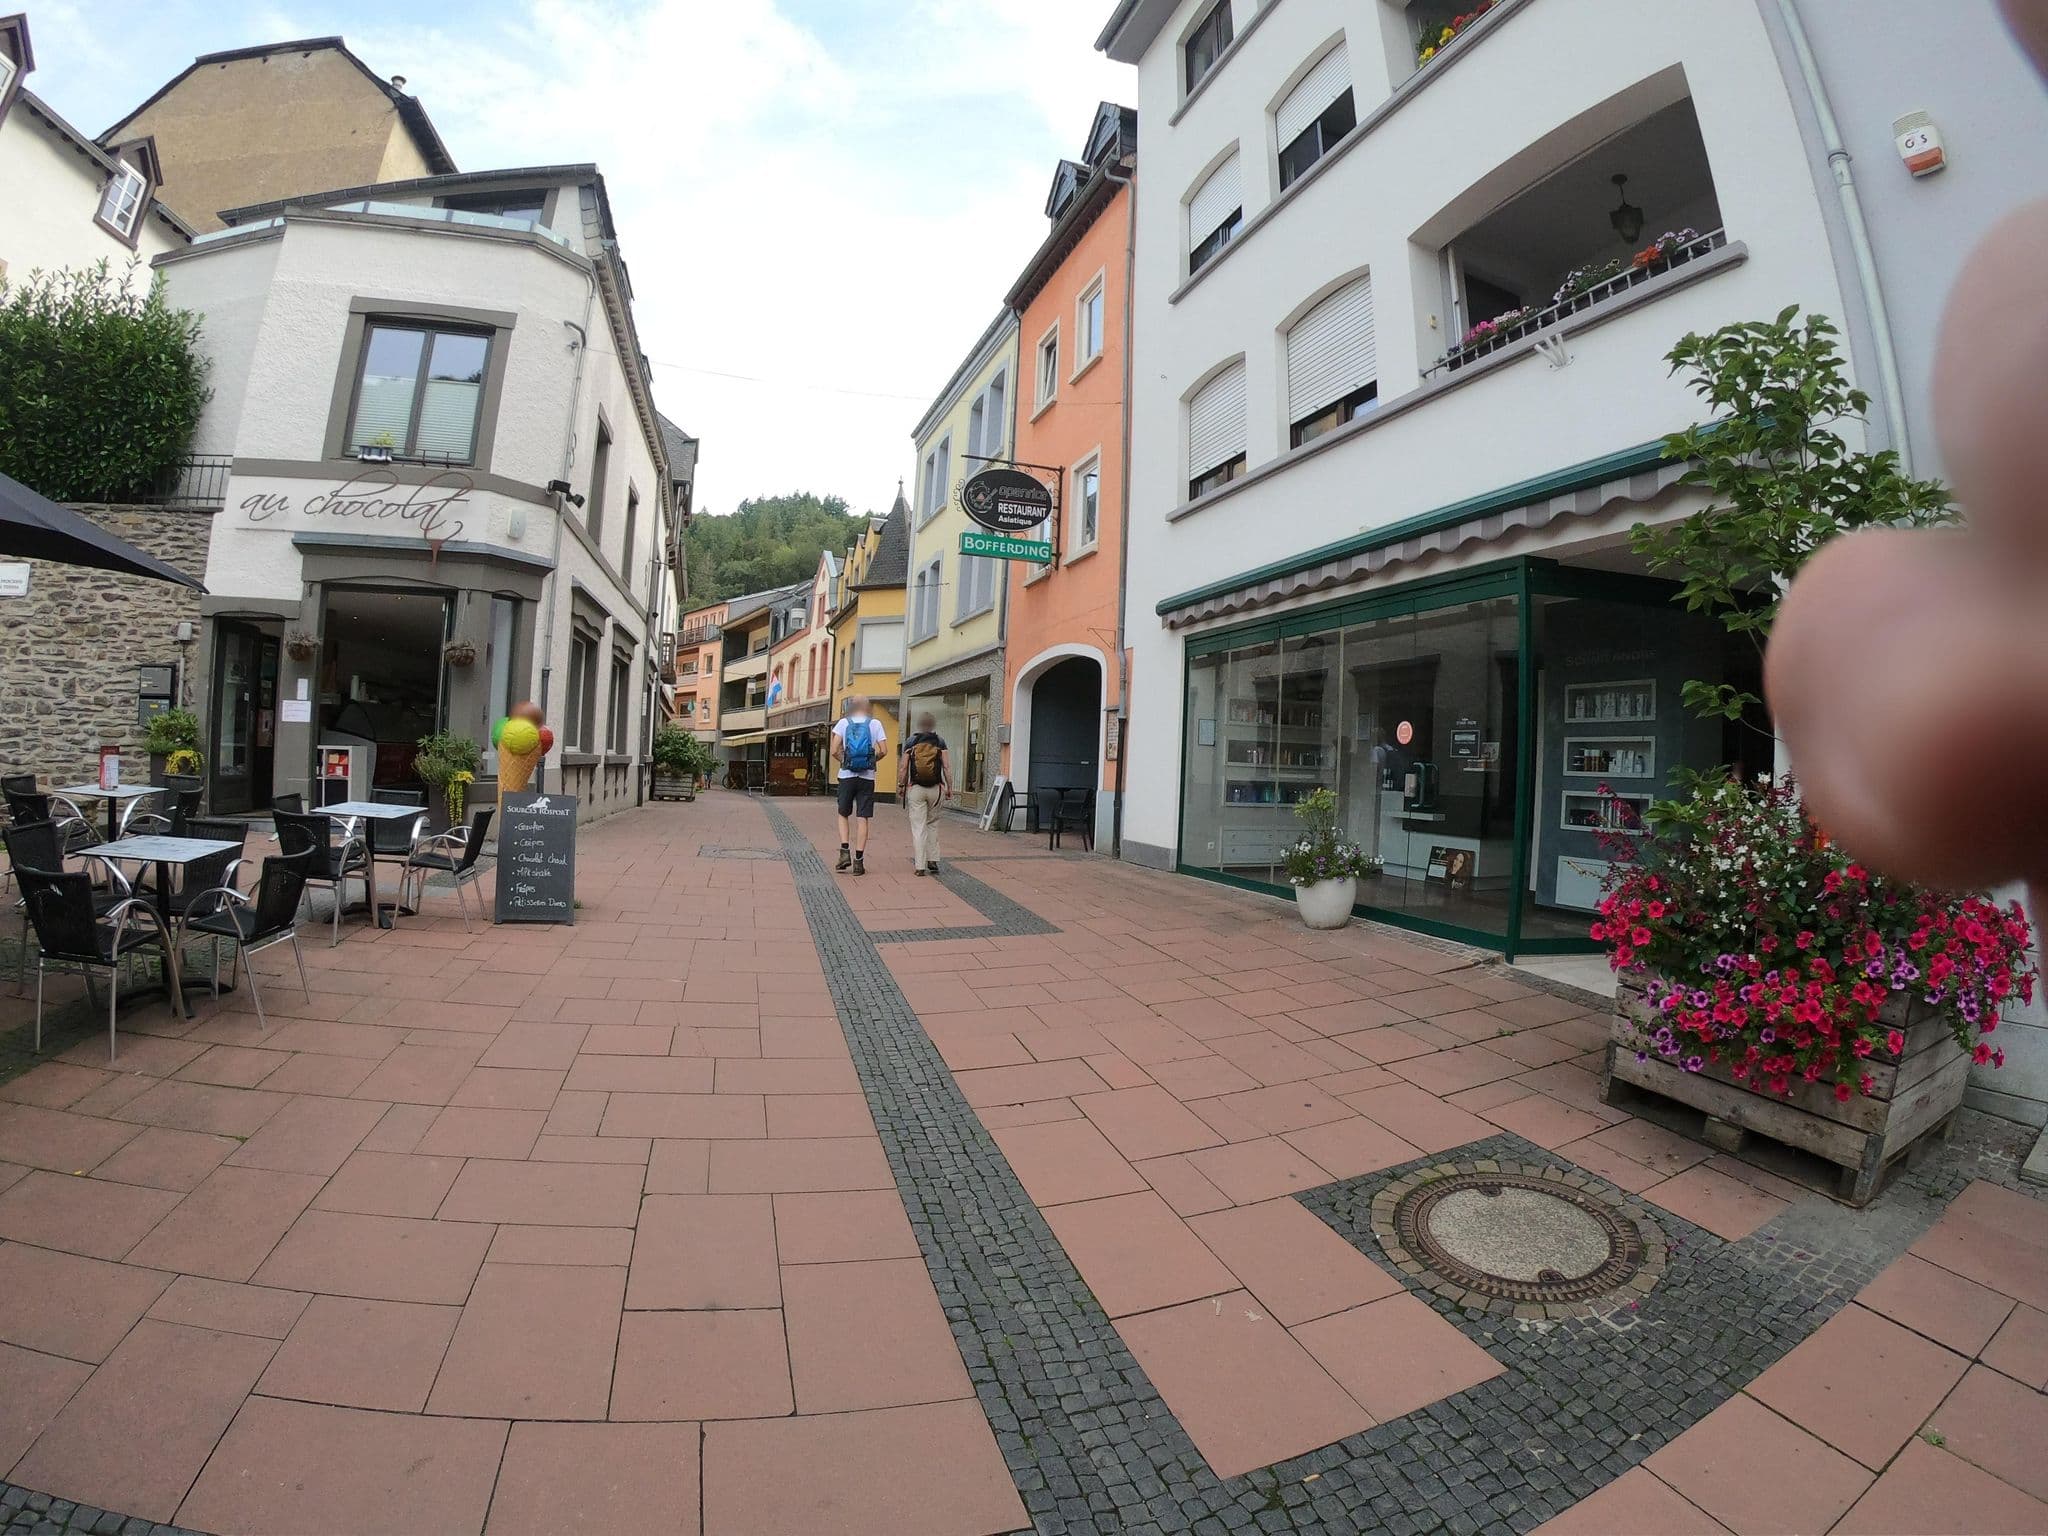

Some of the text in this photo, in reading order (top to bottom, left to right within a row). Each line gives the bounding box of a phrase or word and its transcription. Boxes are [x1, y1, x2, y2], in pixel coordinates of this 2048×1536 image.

[239, 469, 474, 545] au chocolat
[998, 503, 1047, 517] RESTAURANT
[998, 515, 1033, 525] Asiatique
[964, 537, 1050, 558] BOFFERDING
[507, 806, 537, 814] SOURCES
